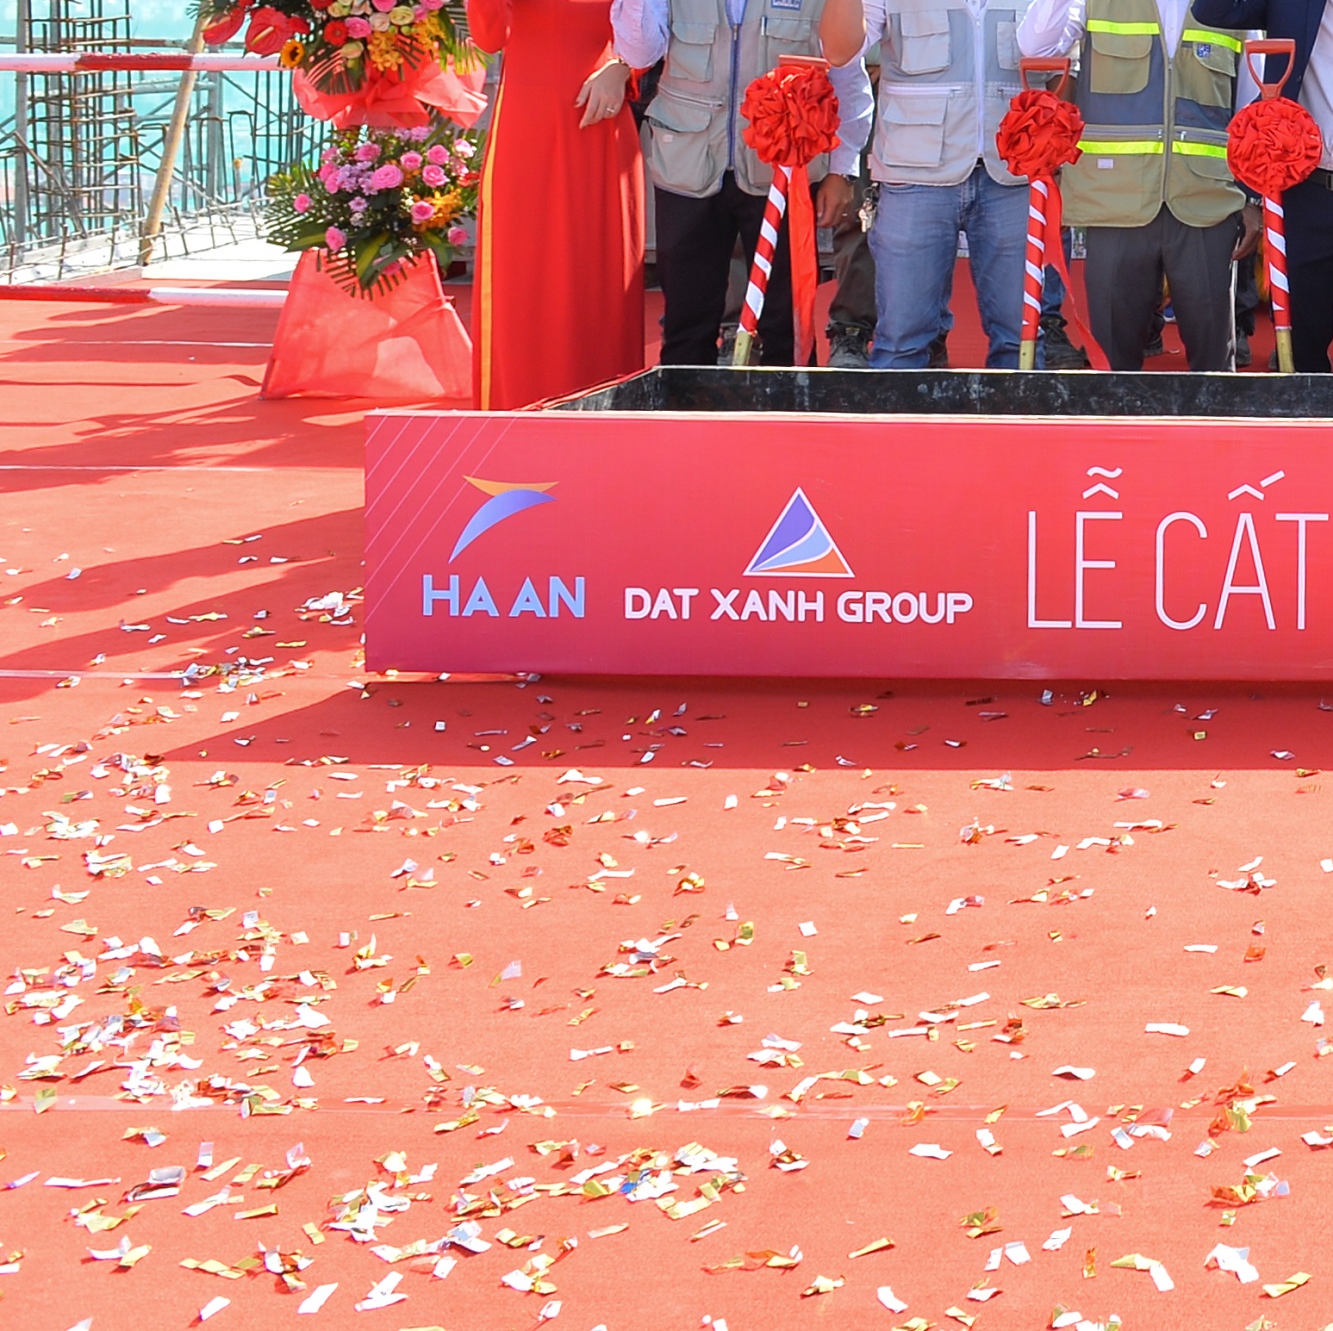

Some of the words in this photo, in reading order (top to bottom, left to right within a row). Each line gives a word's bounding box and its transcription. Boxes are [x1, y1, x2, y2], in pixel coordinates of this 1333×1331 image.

[1027, 466, 1124, 629] LỄ
[1155, 469, 1329, 631] CẤT
[423, 575, 499, 618] HA
[510, 576, 586, 618] AN
[624, 588, 699, 620] DAT
[711, 588, 824, 622] XANH
[837, 591, 973, 624] GROUP
